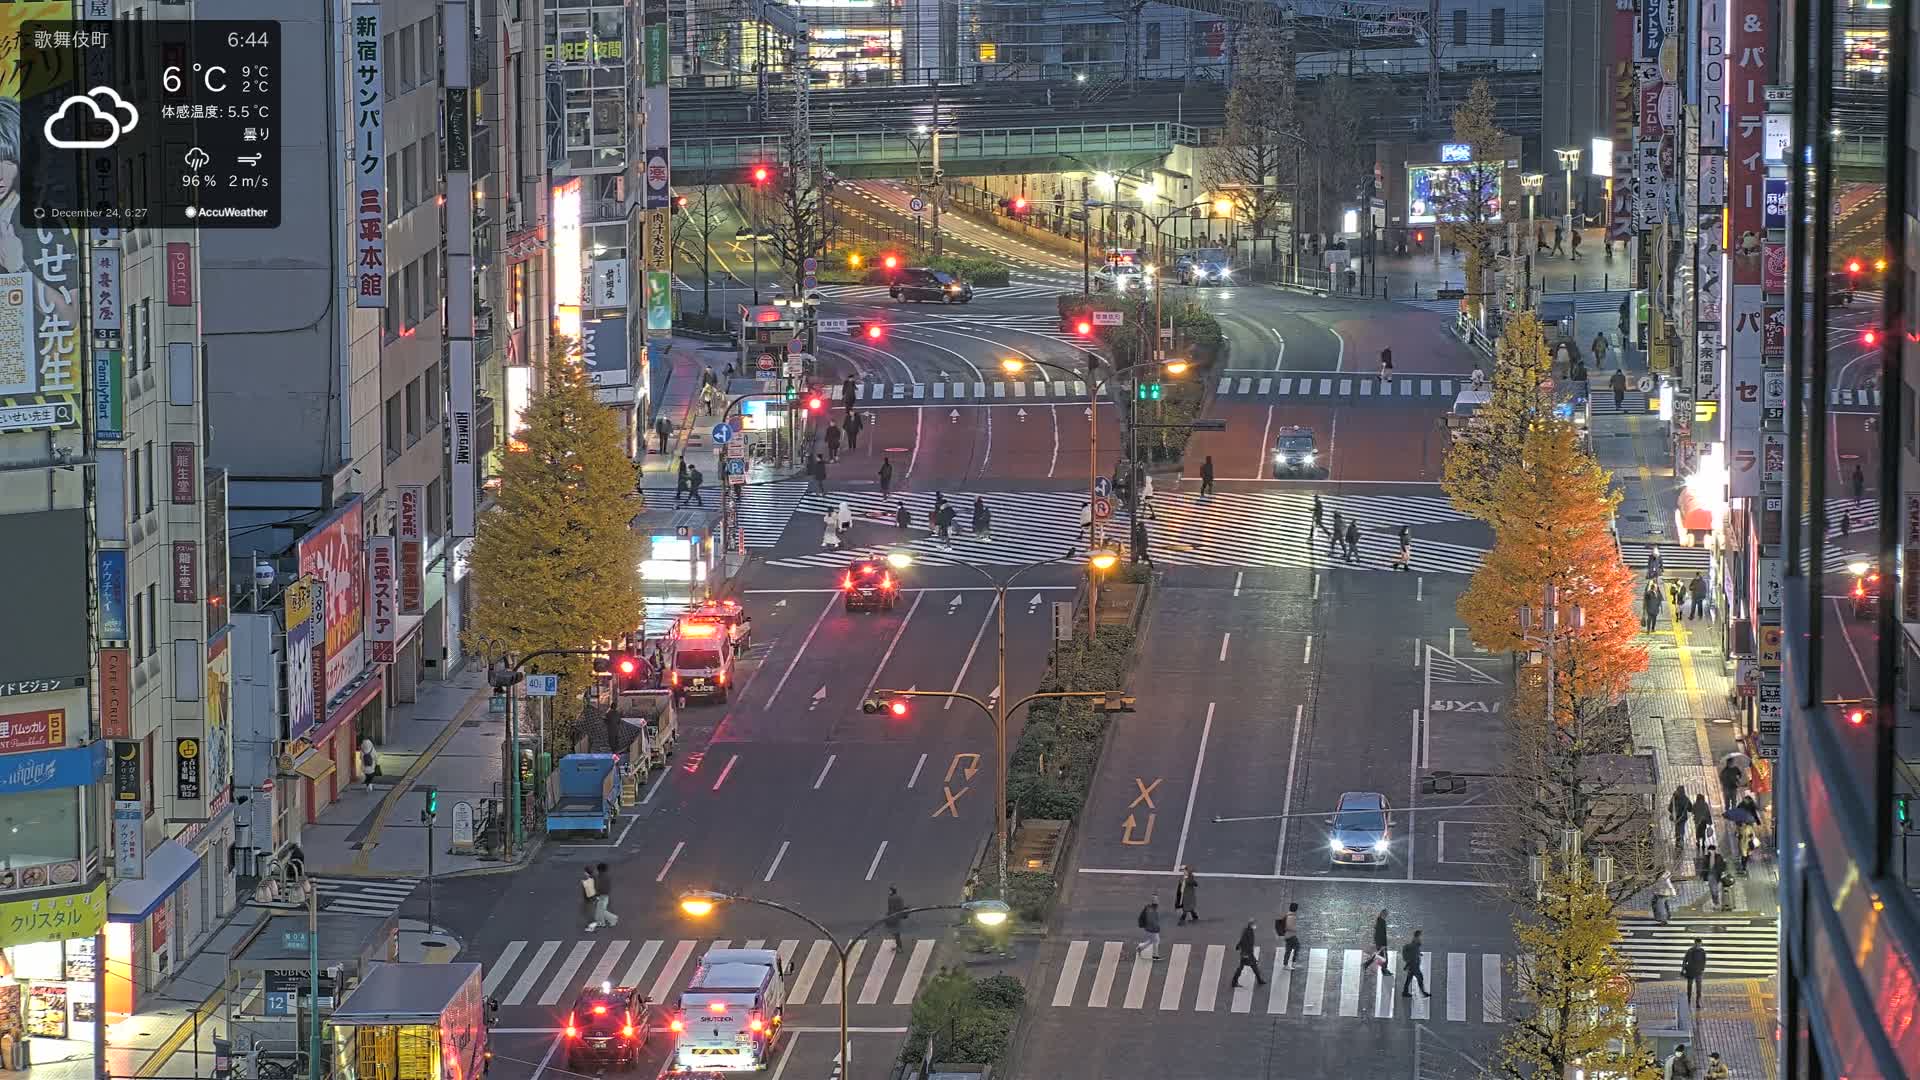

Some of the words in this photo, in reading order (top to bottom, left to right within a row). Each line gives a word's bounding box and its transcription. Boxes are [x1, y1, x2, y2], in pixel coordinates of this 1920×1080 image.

[356, 15, 380, 174] 新宿サンパーク
[1739, 14, 1764, 208] &パーティー
[359, 188, 383, 297] 三平本館
[99, 330, 116, 339] 3F
[1700, 334, 1713, 386] 大衆酒場
[97, 359, 110, 420] FamilyMart
[1735, 311, 1761, 473] パセラ
[402, 492, 413, 536] GAME
[178, 553, 192, 588] 龍生堂
[374, 547, 390, 635] 三平ストア
[50, 716, 61, 741] 5F
[9, 908, 82, 933] クリスタル
[268, 996, 284, 1009] 12
